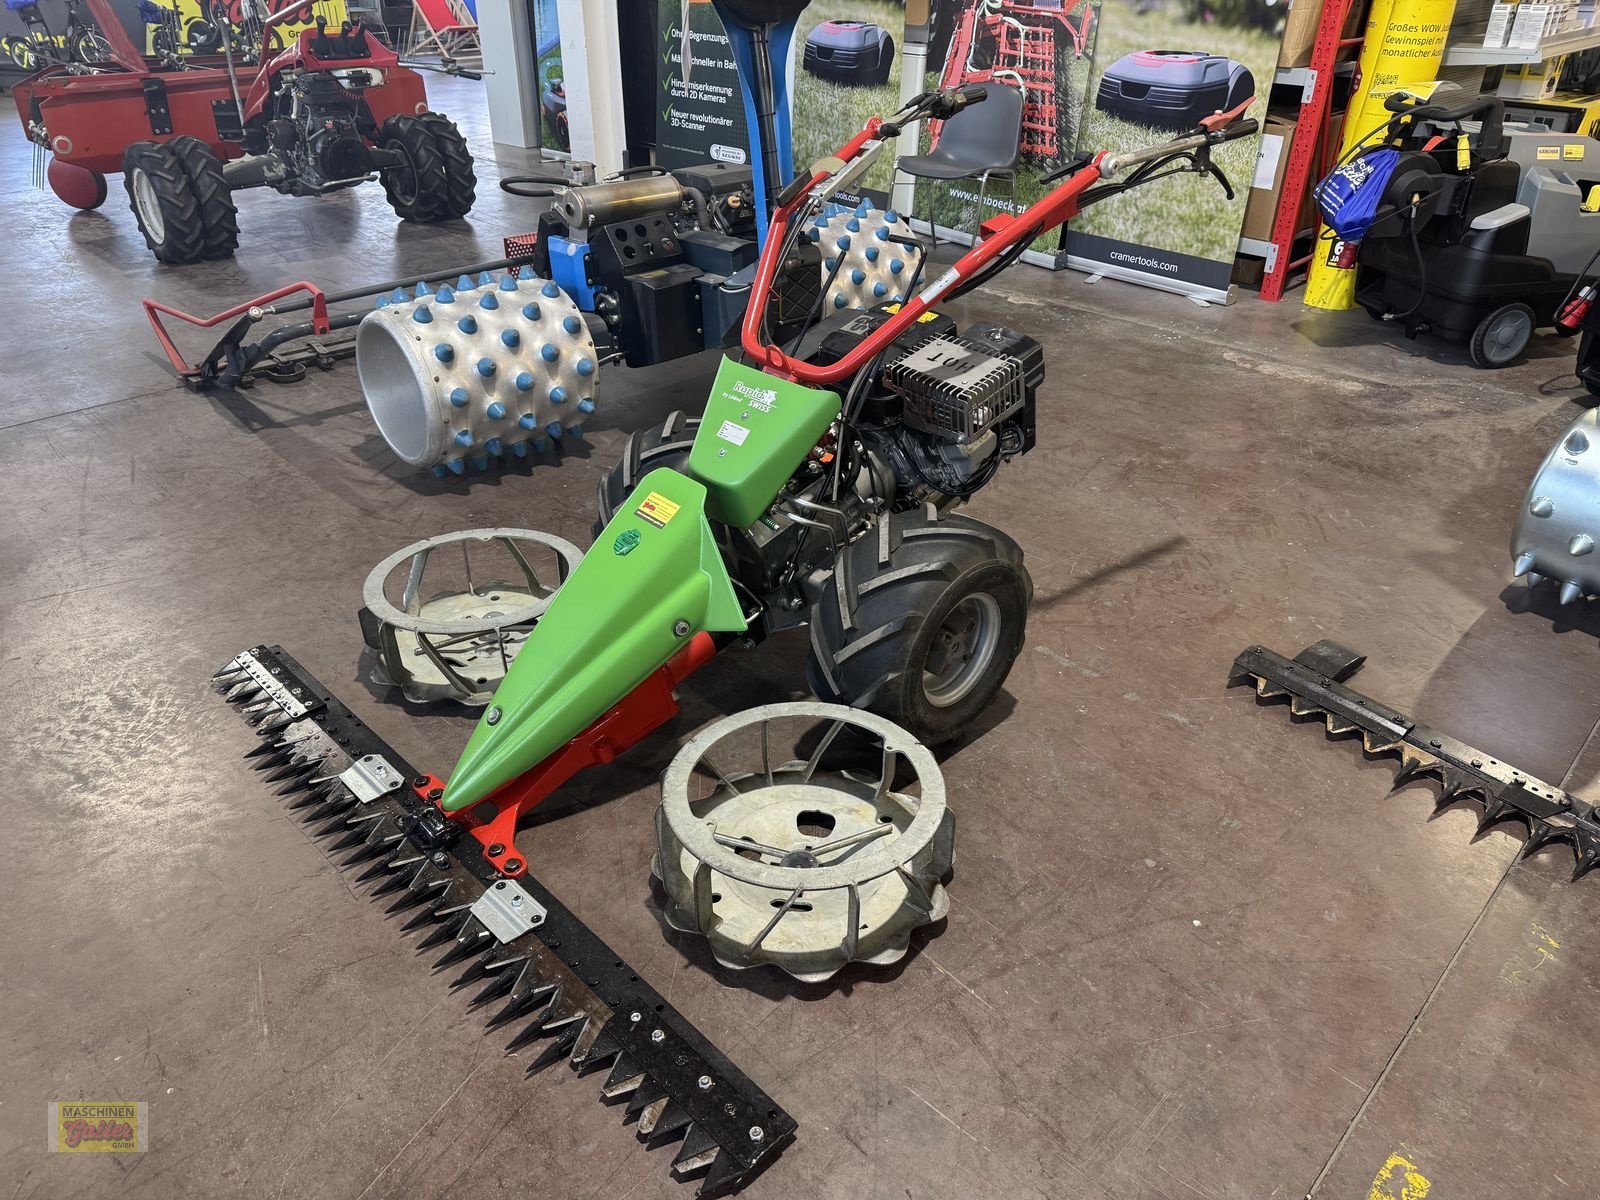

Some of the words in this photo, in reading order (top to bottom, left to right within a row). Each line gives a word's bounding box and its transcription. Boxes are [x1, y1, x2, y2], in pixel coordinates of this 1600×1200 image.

[1388, 23, 1418, 33] Großes
[1421, 24, 1441, 33] WOW
[671, 28, 684, 38] Ohn
[688, 30, 729, 45] Begrenzungs
[1385, 35, 1435, 46] Gewinnspiel
[1381, 48, 1430, 58] monatlicher
[691, 56, 716, 69] chneller
[717, 60, 723, 69] in
[723, 60, 738, 70] Bah
[671, 89, 688, 99] durch
[689, 90, 698, 99] 2D
[699, 92, 727, 104] Kameras
[671, 108, 689, 119] Neuer
[690, 111, 734, 127] revolutionärer
[671, 118, 706, 131] 3D-Scanner
[1334, 241, 1345, 256] 6
[1110, 251, 1178, 273] cramertools.com
[926, 352, 975, 374] HOT
[733, 380, 767, 403] Rapid
[748, 400, 771, 413] SWISS
